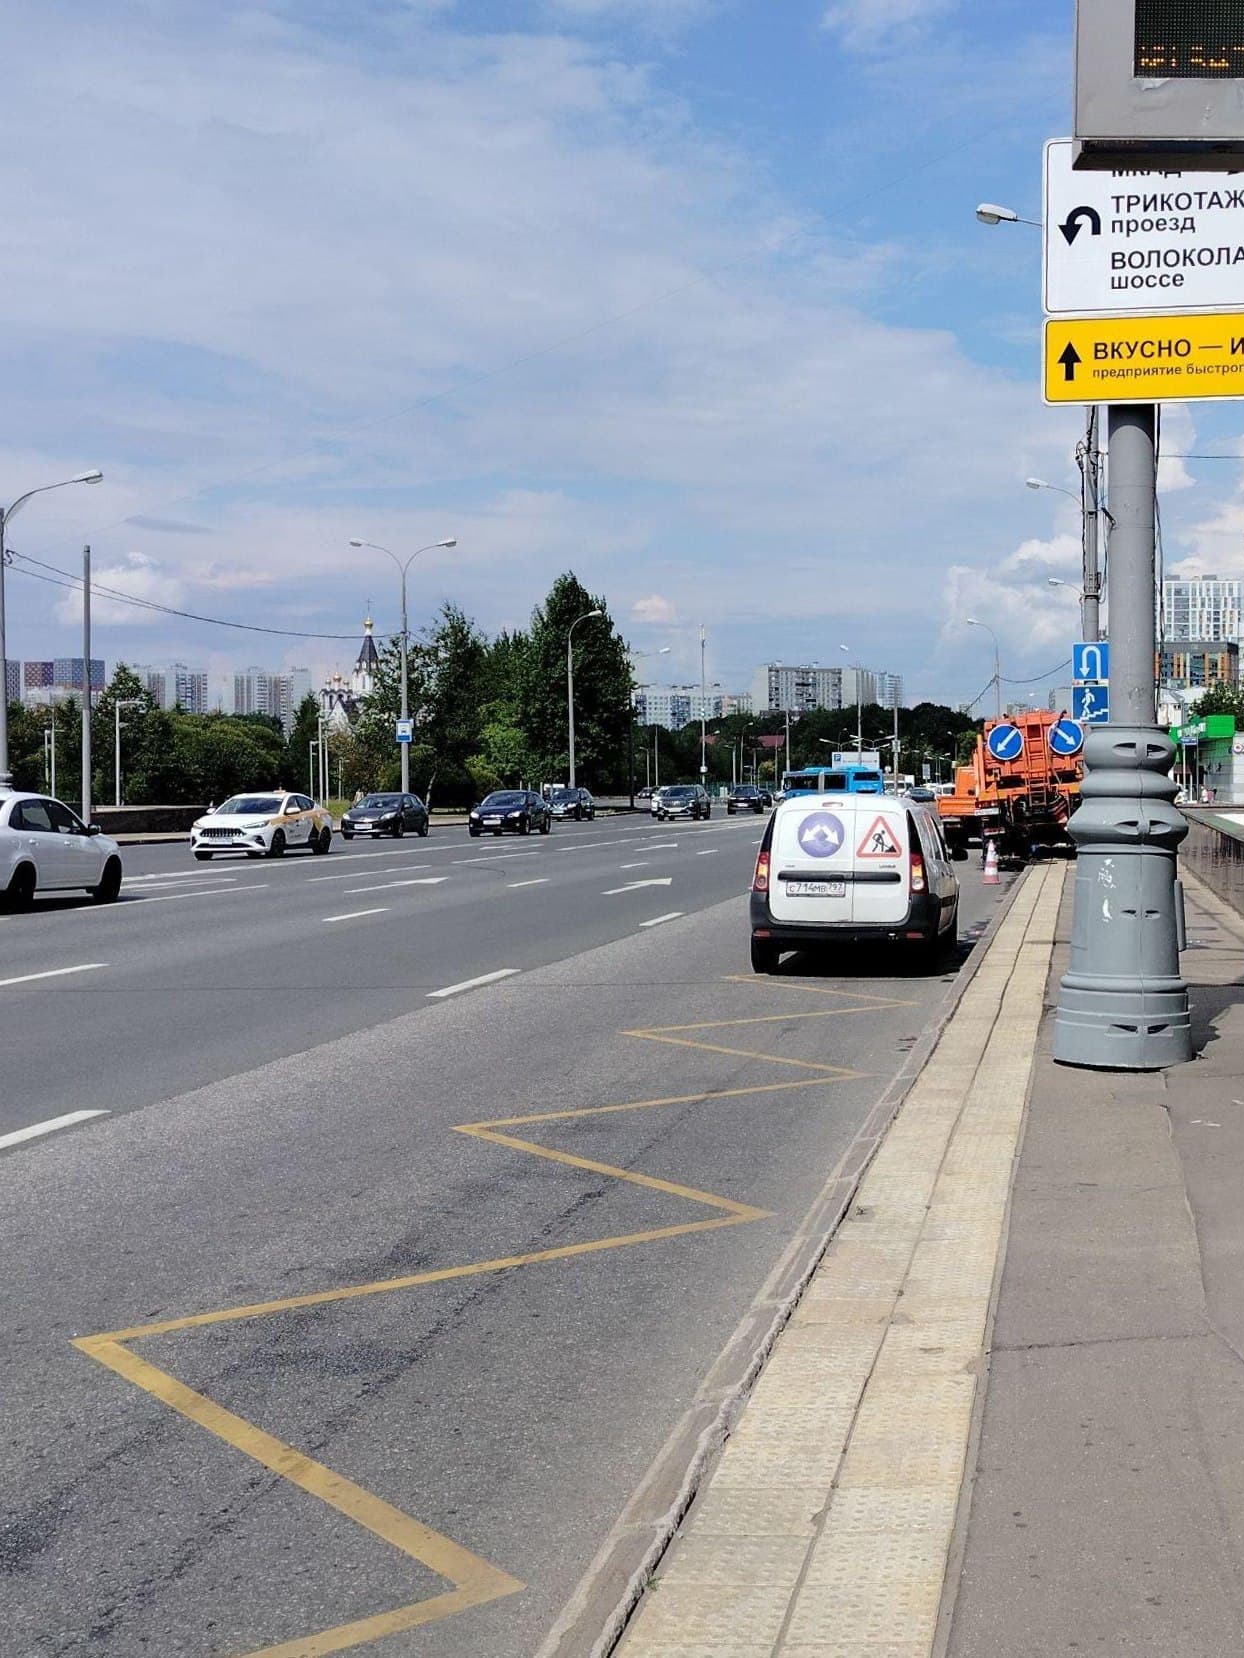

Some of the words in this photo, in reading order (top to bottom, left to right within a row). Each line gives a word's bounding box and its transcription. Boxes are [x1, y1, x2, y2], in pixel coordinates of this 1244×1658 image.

[1111, 217, 1196, 237] проезд
[1111, 273, 1185, 290] шоссе
[1093, 339, 1191, 360] ВКУСНО
[1092, 365, 1182, 379] предприятие
